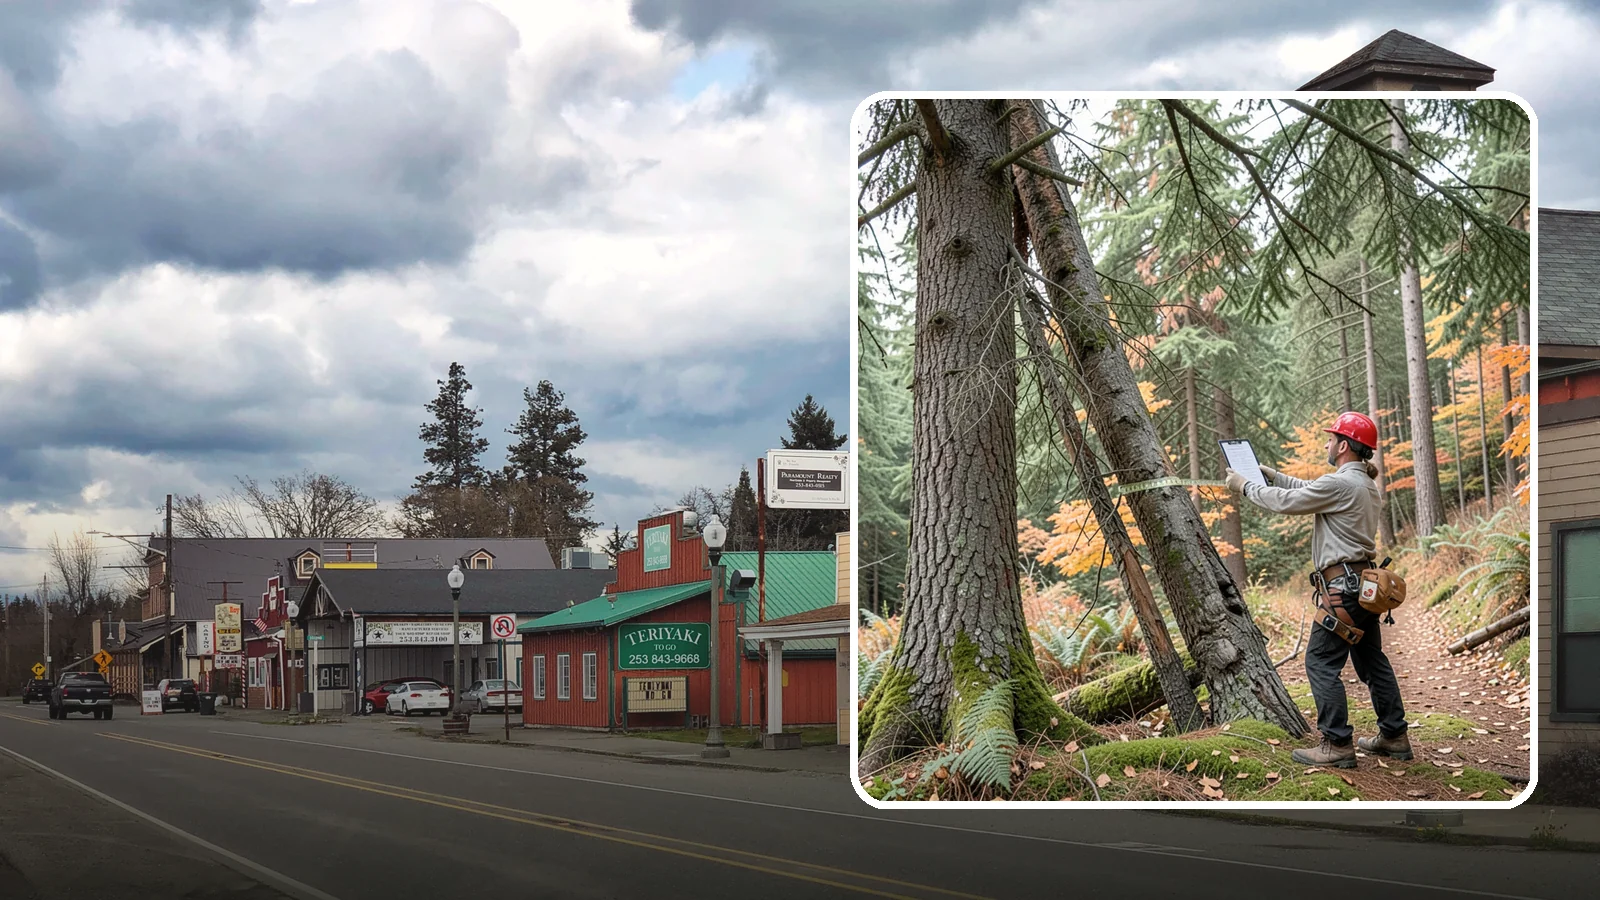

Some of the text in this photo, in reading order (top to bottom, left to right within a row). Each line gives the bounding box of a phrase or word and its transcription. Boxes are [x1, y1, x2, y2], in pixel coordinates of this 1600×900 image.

[625, 628, 702, 646] TERIYAKI
[629, 654, 700, 664] 253 843-9668
